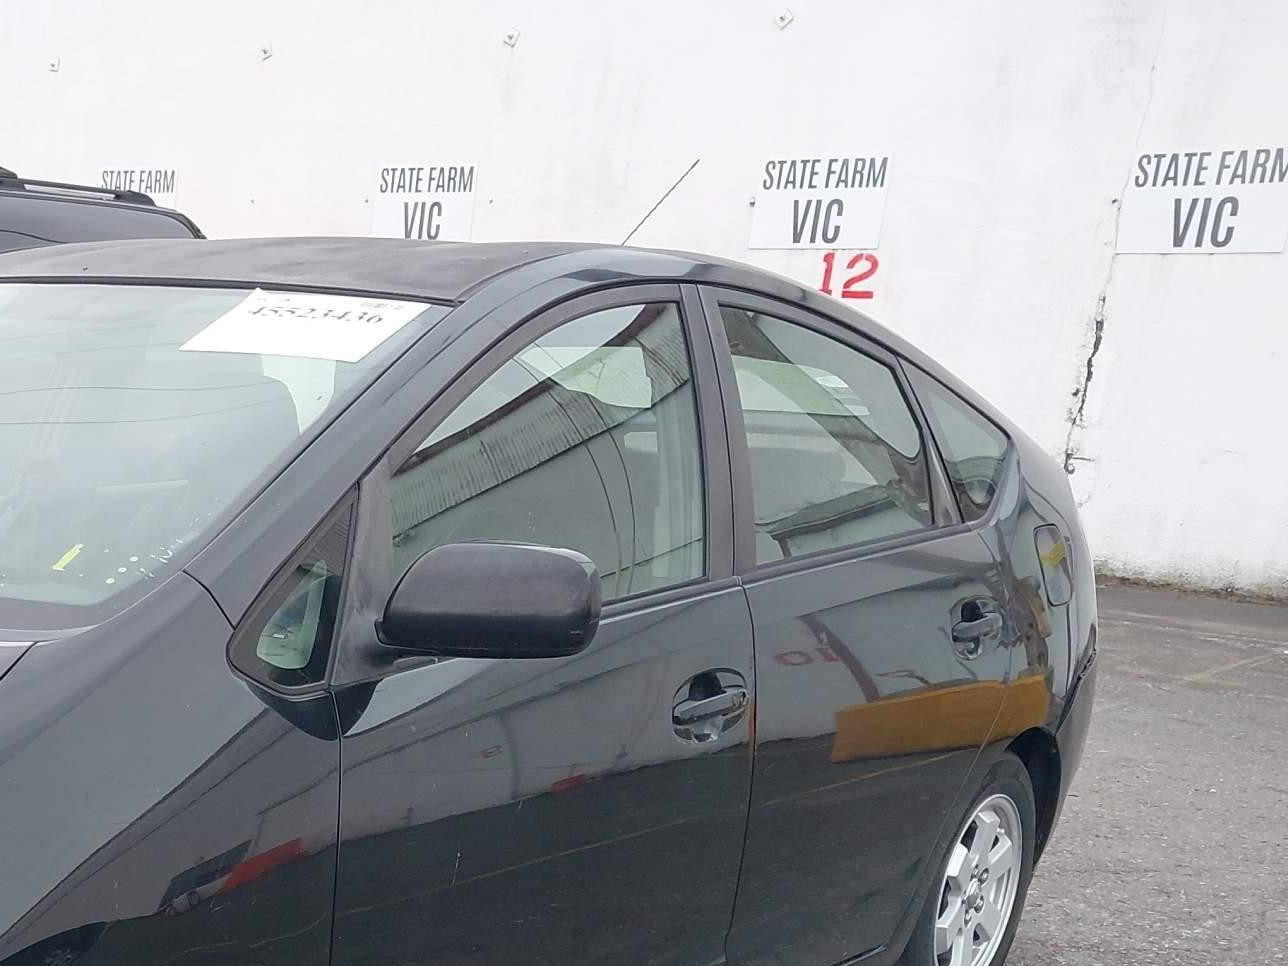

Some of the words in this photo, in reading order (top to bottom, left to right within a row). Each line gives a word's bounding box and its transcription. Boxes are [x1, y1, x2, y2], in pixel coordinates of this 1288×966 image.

[102, 169, 136, 192] STATE
[138, 169, 175, 193] FARM
[379, 167, 423, 194] STATE
[427, 166, 474, 193] FARM
[762, 159, 822, 191] STATE
[824, 157, 888, 189] FARM
[1135, 151, 1212, 188] STATE
[1215, 147, 1288, 186] FARM
[404, 201, 442, 240] VIC
[792, 198, 844, 244] VIC
[1172, 196, 1240, 248] VIC
[819, 252, 879, 299] 12
